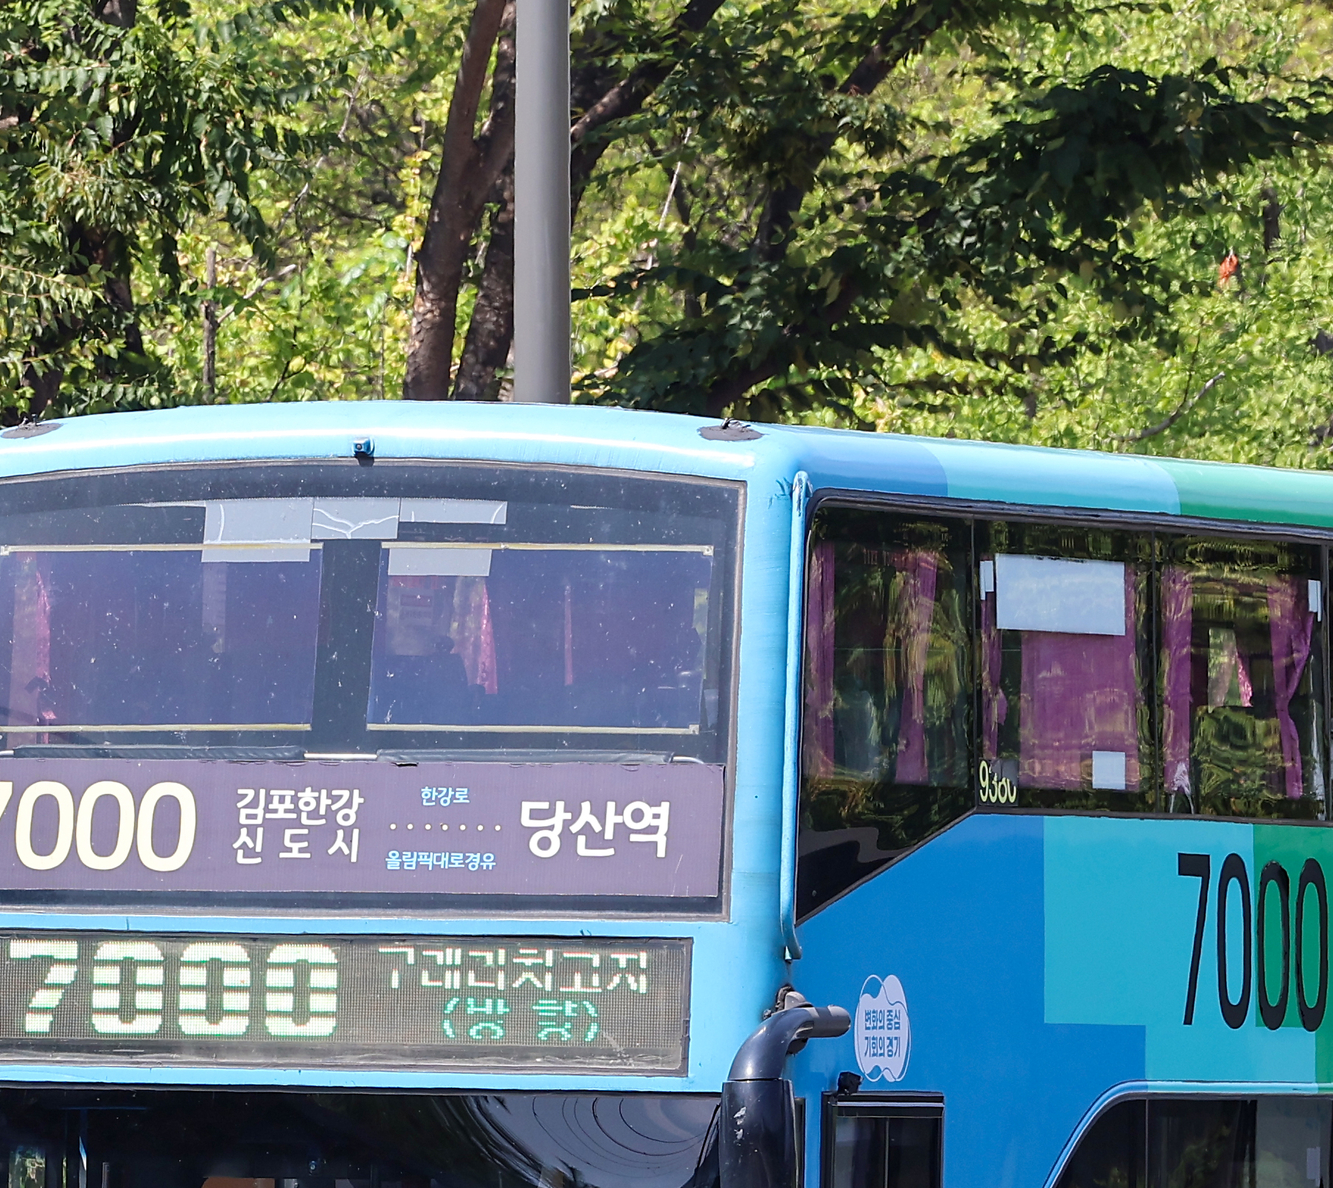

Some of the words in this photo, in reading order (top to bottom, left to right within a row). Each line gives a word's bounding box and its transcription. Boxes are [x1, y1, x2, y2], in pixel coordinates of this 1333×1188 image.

[235, 786, 365, 827] 김포한강
[420, 786, 471, 807] 한강로
[520, 800, 671, 859] 당산역
[385, 850, 497, 872] 올림픽대로경유
[1177, 852, 1329, 1032] 7000
[10, 939, 338, 1037] 7000
[864, 1009, 886, 1030] 변화의
[887, 1009, 901, 1030] 중심
[864, 1036, 886, 1057] 기회의
[887, 1036, 901, 1057] 경기
